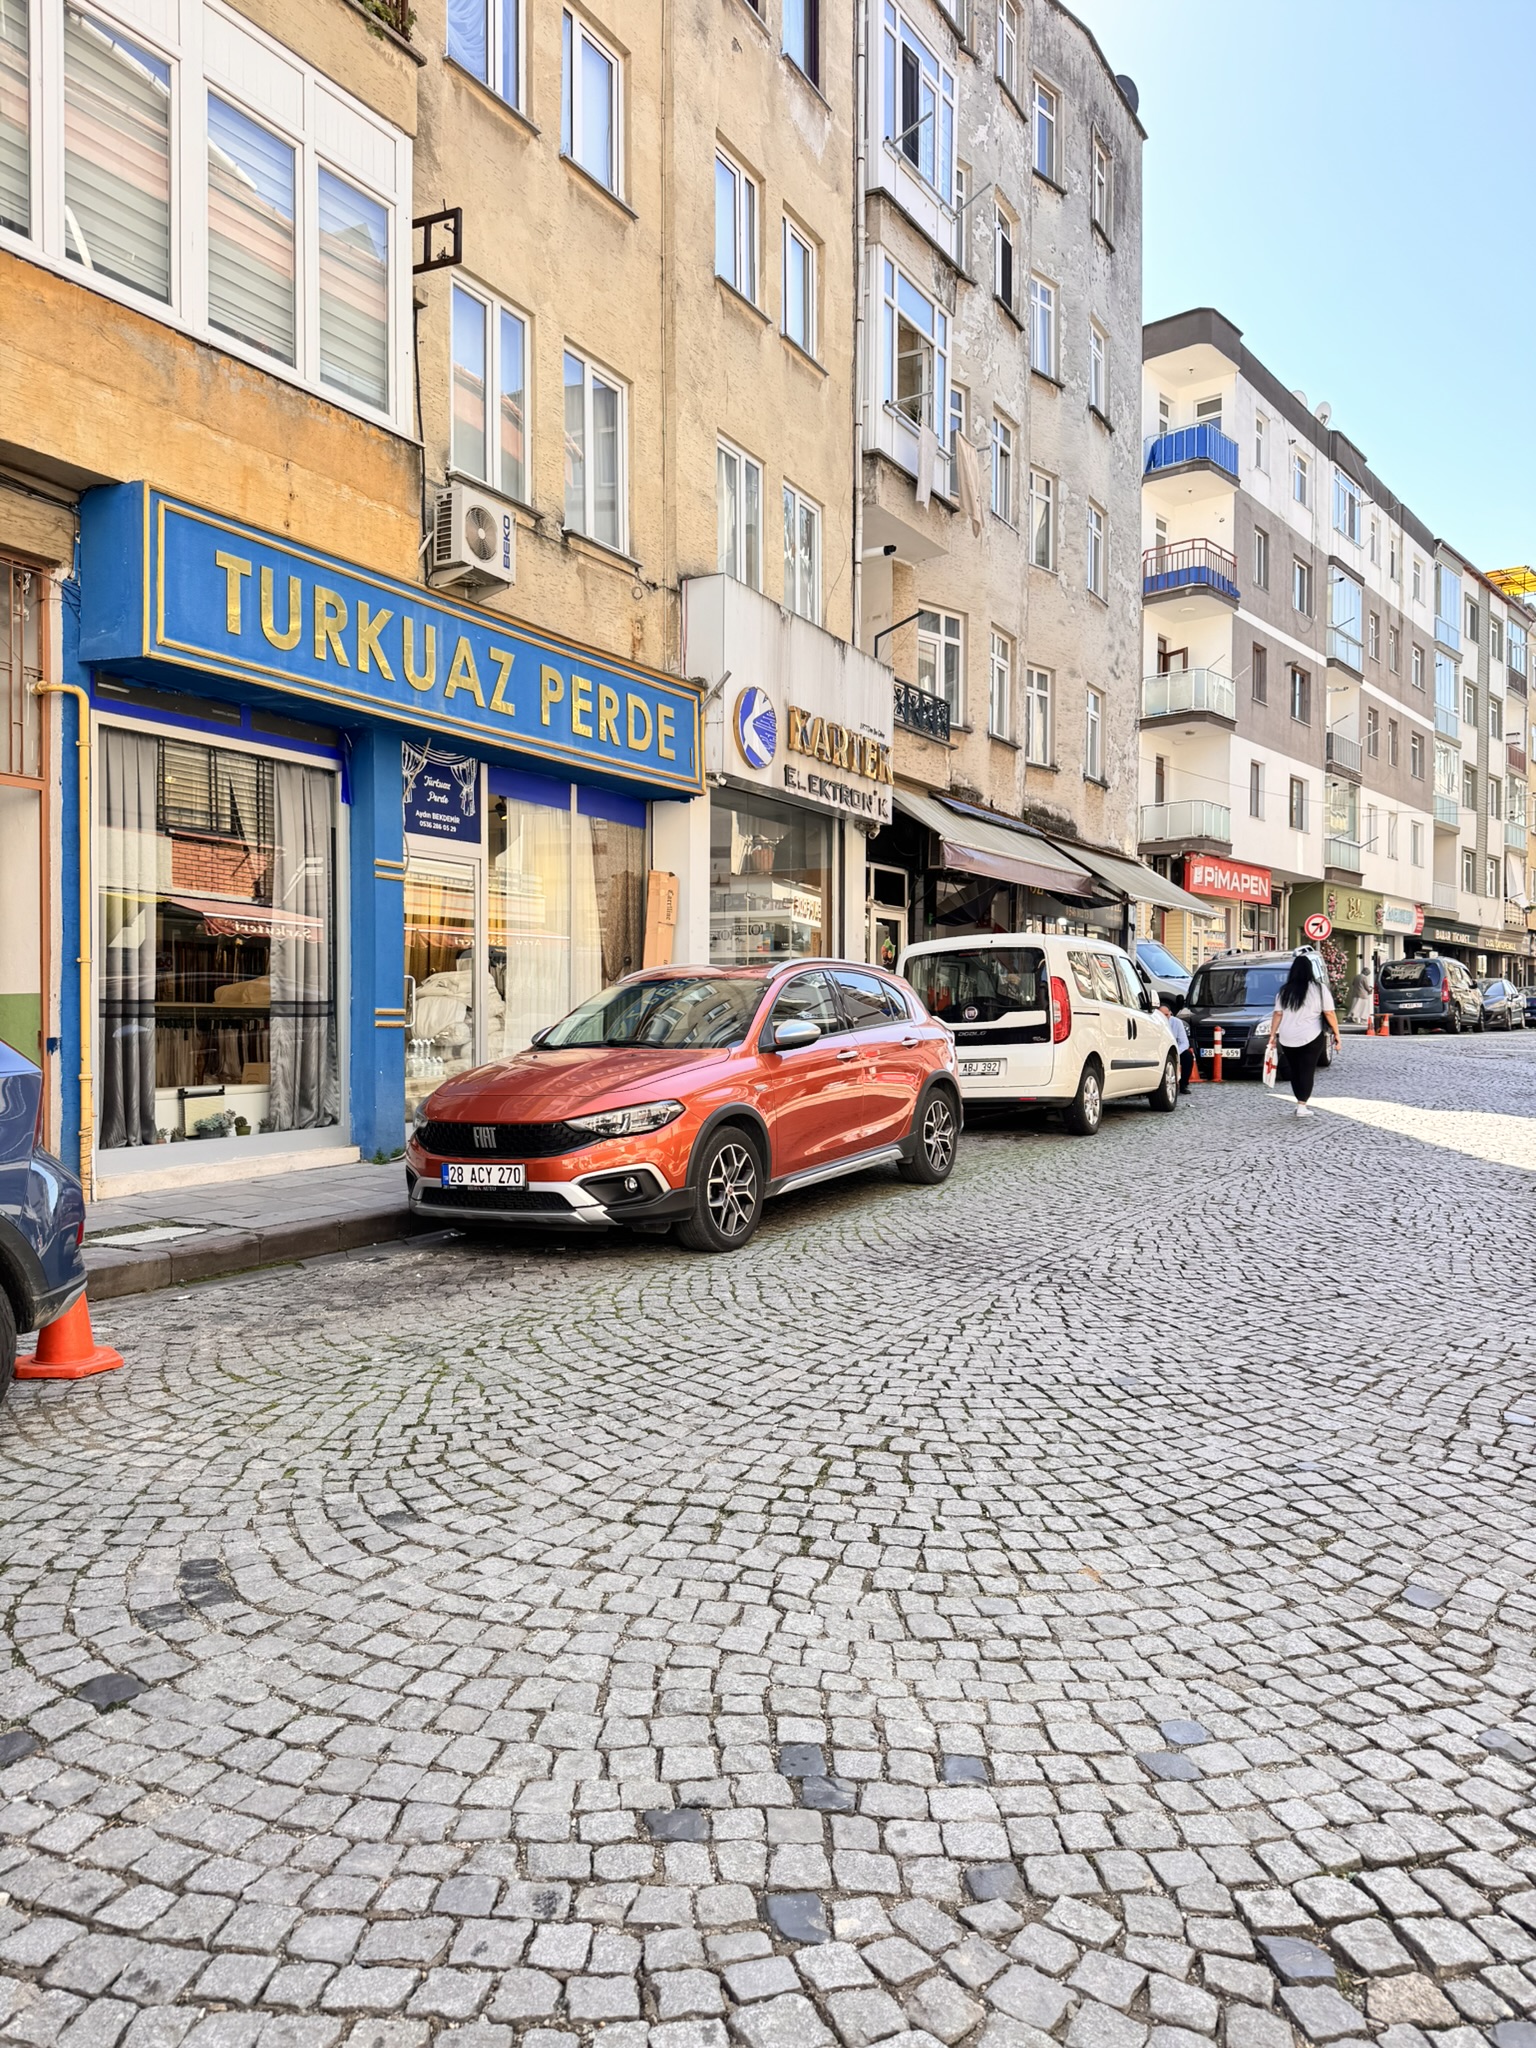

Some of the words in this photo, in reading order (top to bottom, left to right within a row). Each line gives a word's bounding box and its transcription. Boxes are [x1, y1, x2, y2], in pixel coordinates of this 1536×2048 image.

[503, 515, 511, 569] BEKO
[215, 549, 517, 717] TURKUAZ
[540, 664, 677, 761] PERDE
[788, 705, 895, 785] KARTEK
[427, 791, 449, 804] Perde
[1226, 1049, 1239, 1057] 659
[962, 1063, 979, 1072] ABJ
[981, 1062, 998, 1072] 392
[473, 1126, 497, 1149] FIAT
[449, 1166, 464, 1184] 28
[470, 1167, 493, 1184] ACY
[498, 1167, 520, 1184] 270
